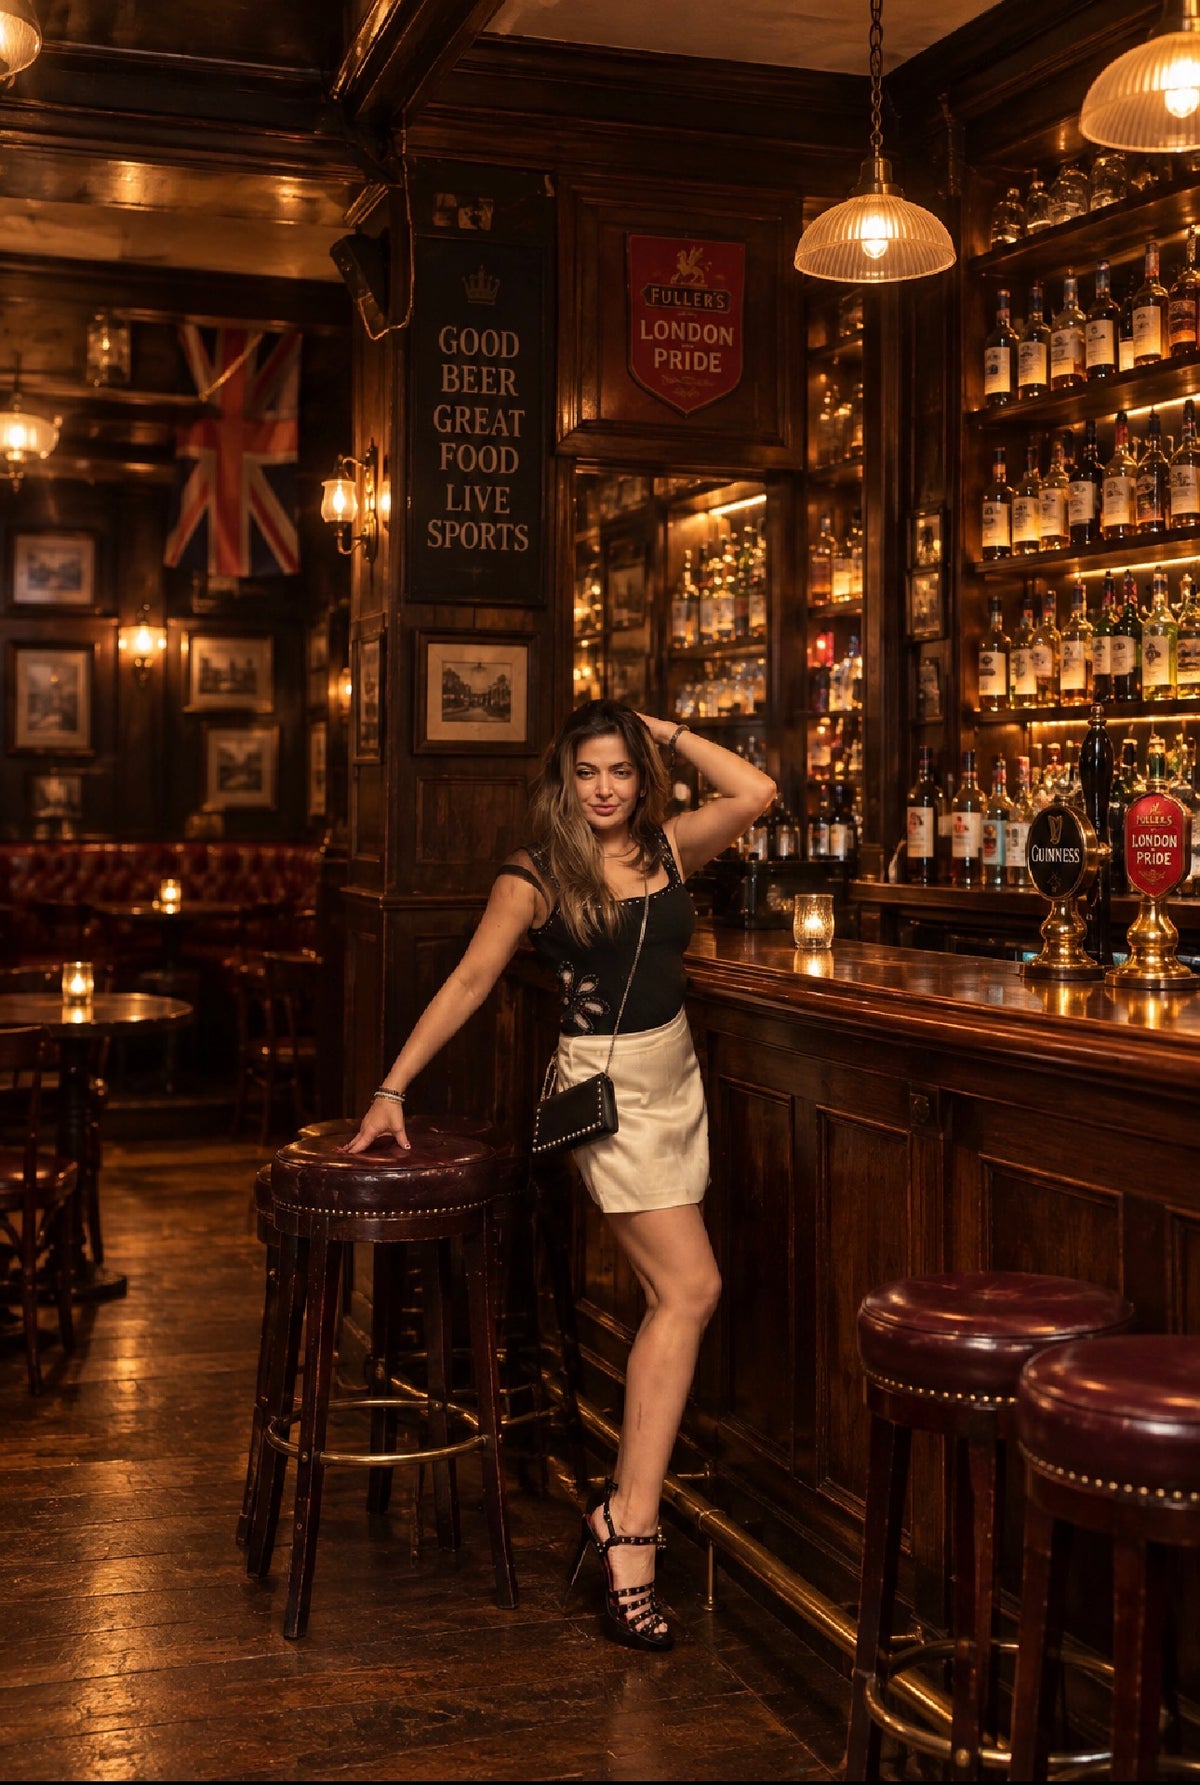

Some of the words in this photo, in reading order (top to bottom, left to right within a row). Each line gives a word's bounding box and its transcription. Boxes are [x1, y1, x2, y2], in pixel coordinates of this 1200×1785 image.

[650, 287, 726, 309] FULLER'S
[438, 325, 520, 359] GOOD
[640, 319, 734, 347] LONDON
[653, 348, 722, 374] PRIDE
[440, 364, 519, 397] BEER
[433, 404, 526, 438] GREAT
[439, 442, 520, 475] FOOD
[445, 483, 511, 514] LIVE
[426, 519, 529, 552] SPORTS
[1031, 844, 1080, 864] GUINNESS
[1132, 834, 1178, 848] LONDON
[1136, 851, 1172, 866] PRIDE
